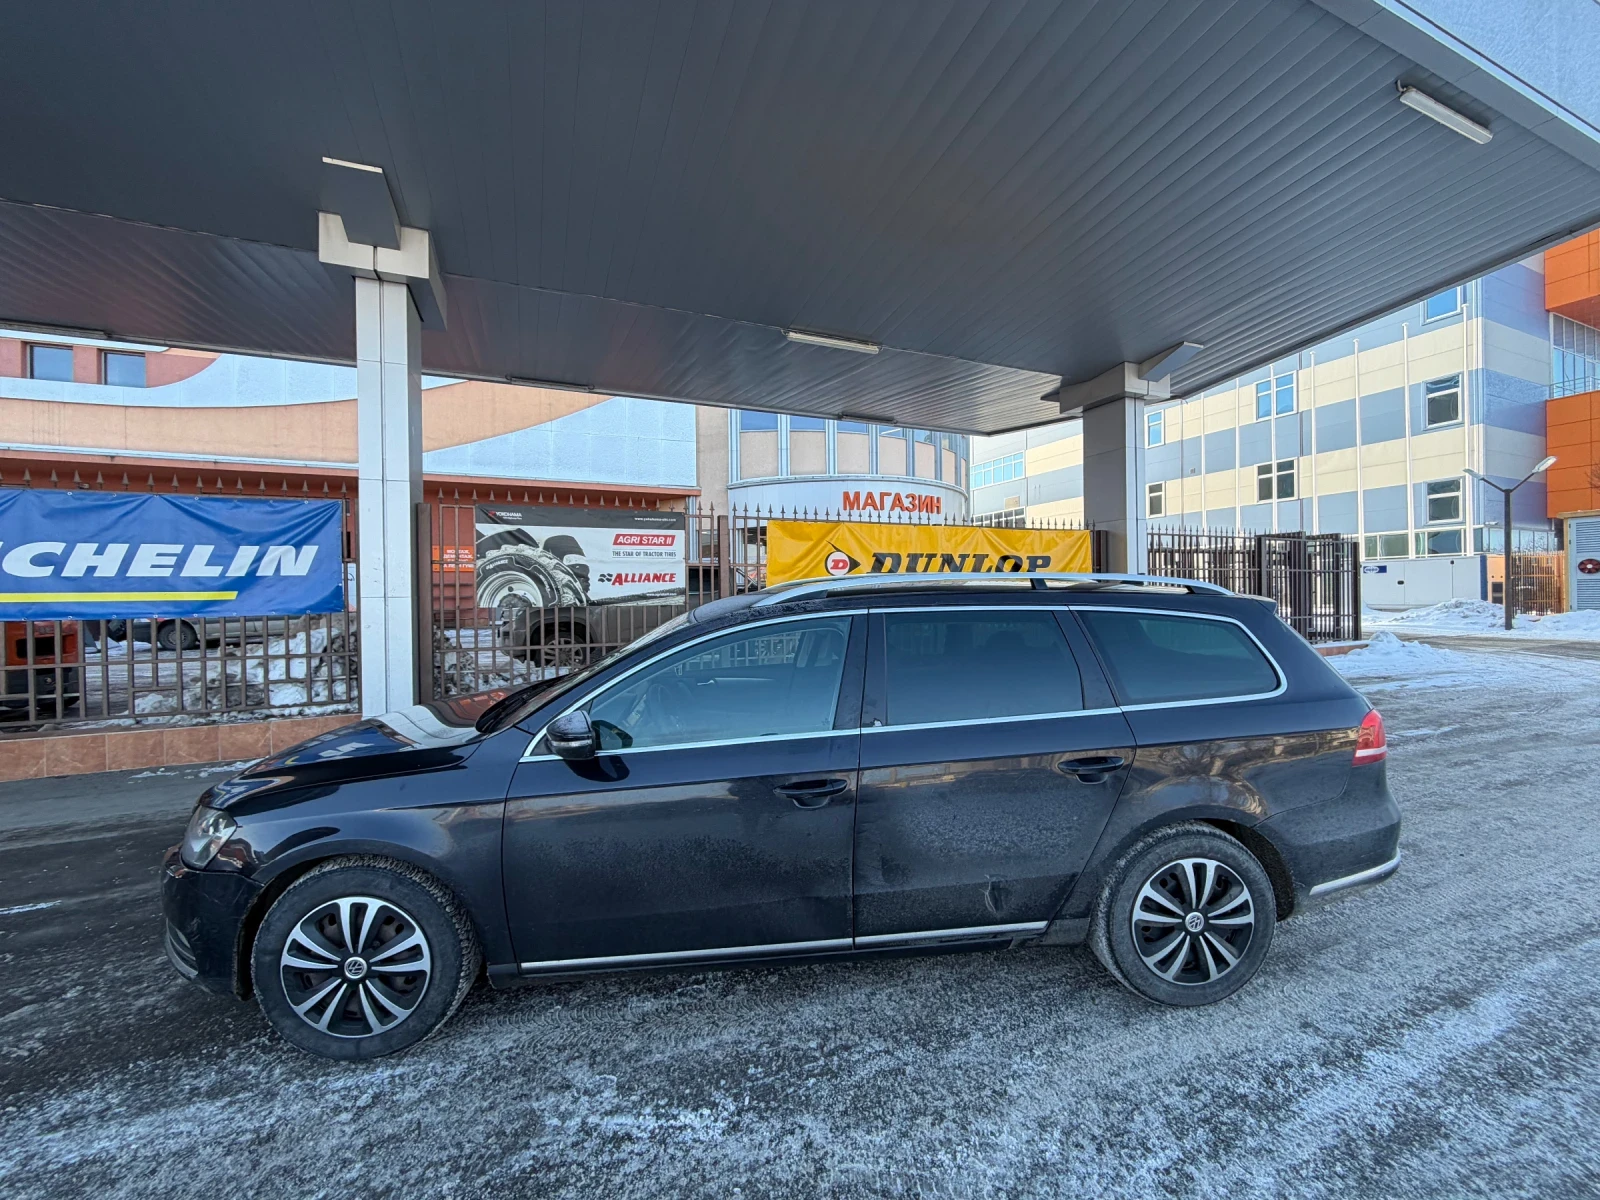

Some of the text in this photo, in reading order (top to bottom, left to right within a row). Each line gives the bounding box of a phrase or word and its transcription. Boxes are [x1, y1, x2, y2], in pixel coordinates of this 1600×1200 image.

[843, 491, 941, 514] МАГАЗИН
[617, 535, 672, 545] AGRI STAR II
[0, 541, 319, 578] CHELIN
[866, 552, 1052, 573] DUNLOP
[611, 573, 676, 586] ALLIANCE
